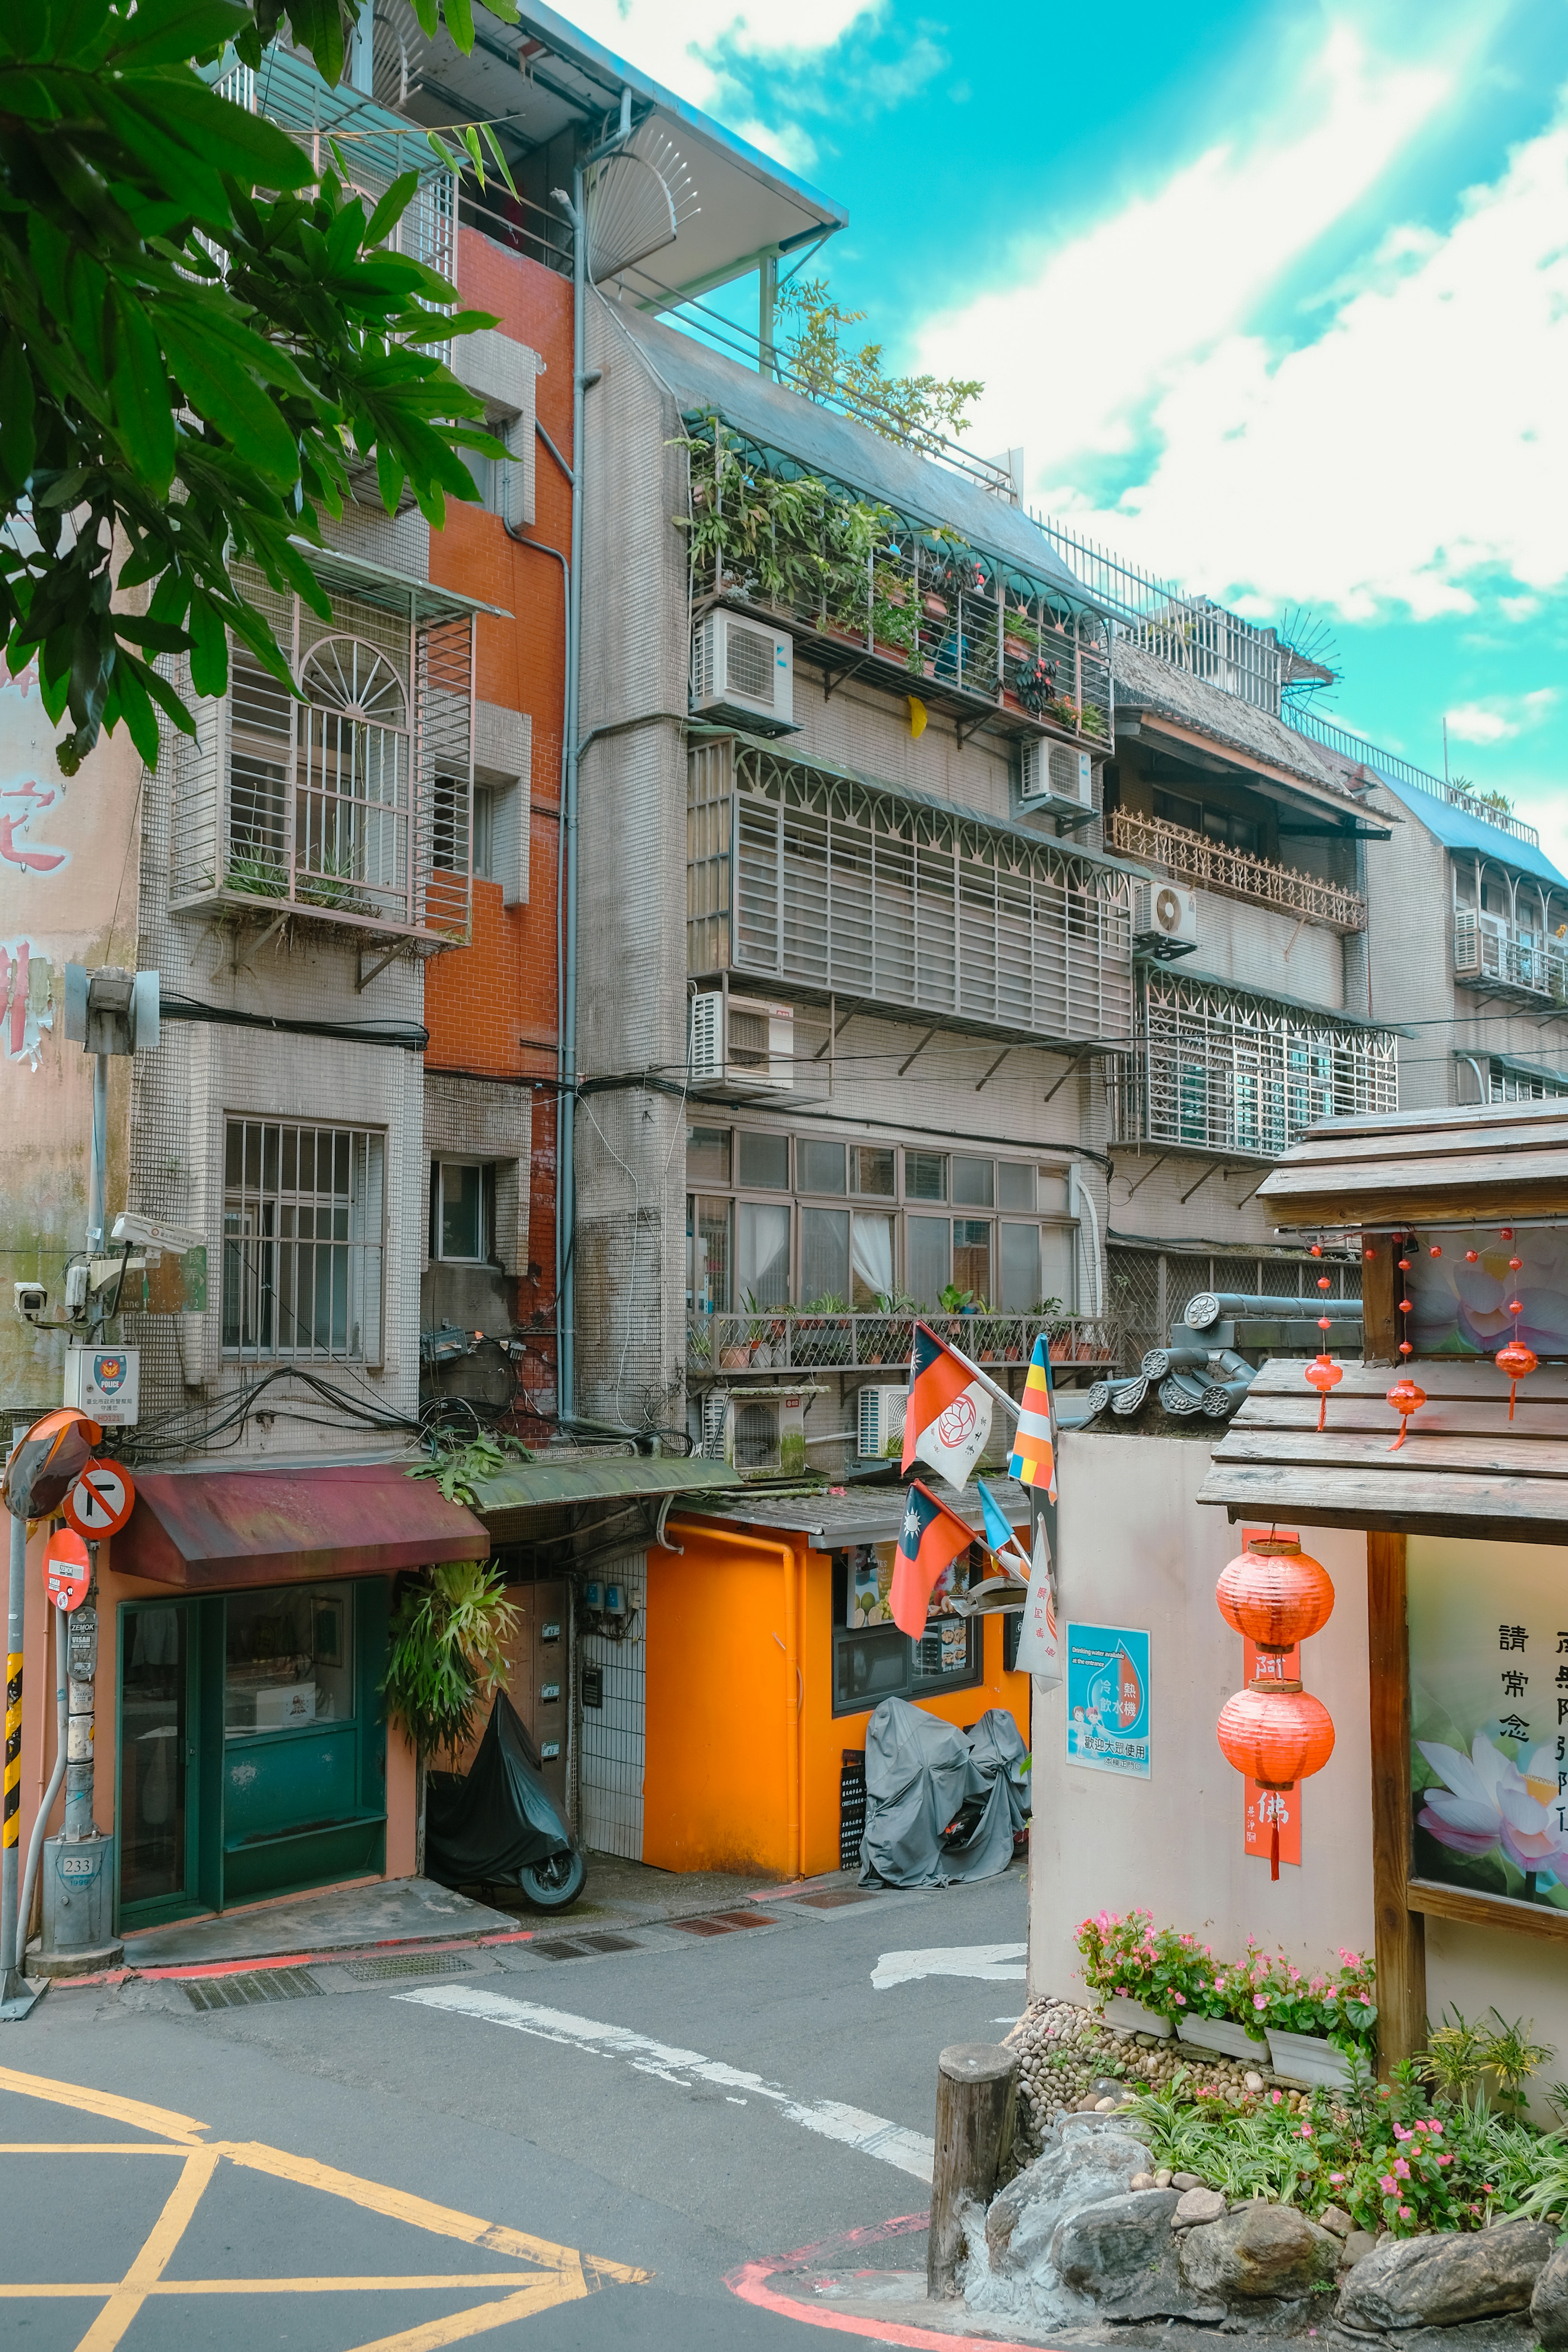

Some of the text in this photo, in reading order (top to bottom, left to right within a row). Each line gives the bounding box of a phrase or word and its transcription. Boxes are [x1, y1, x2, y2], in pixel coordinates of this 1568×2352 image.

[119, 1297, 140, 1308] Lane
[1072, 1647, 1091, 1656] Drinking
[1100, 1679, 1136, 1698] 冷、熱
[1499, 1625, 1530, 1743] 請常念
[1100, 1697, 1136, 1717] 飲水機
[1085, 1736, 1145, 1759] 歡迎大眾使用
[65, 1860, 89, 1872] 233
